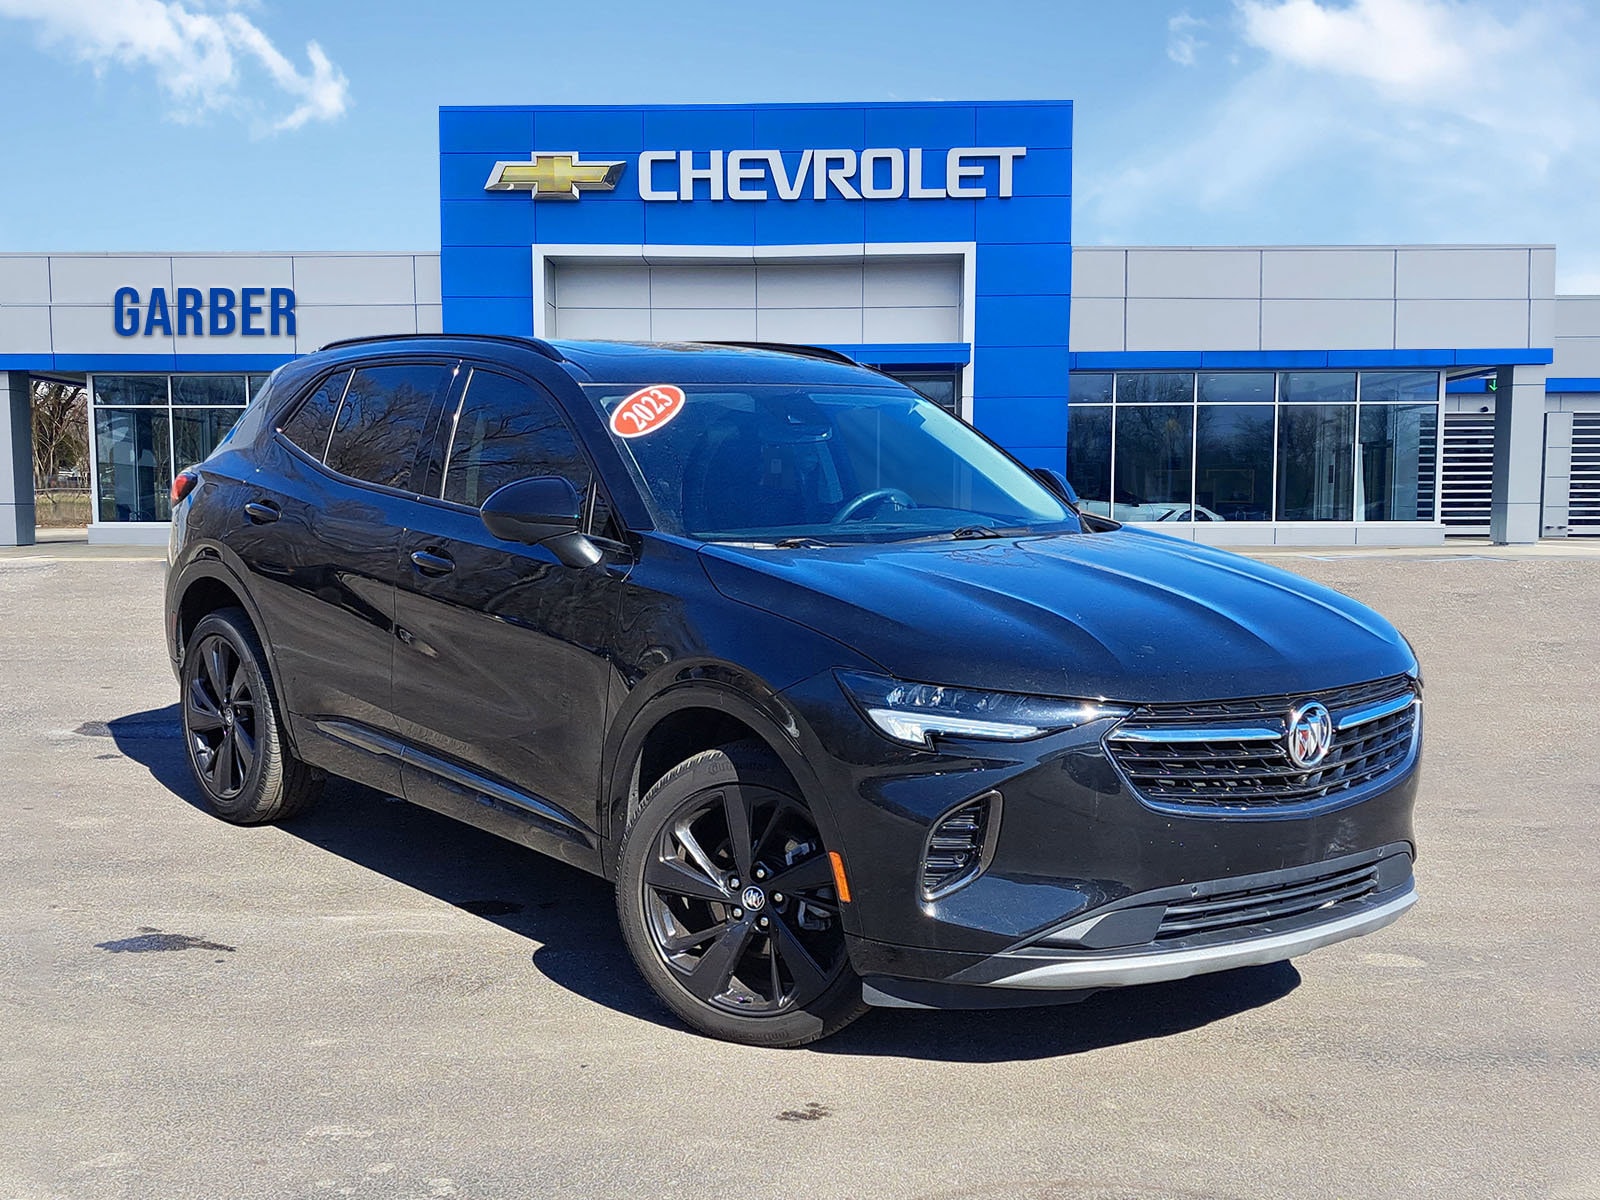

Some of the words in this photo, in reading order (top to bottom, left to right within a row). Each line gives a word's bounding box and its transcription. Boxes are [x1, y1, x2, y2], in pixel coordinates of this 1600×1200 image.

[638, 146, 1027, 202] CHEVROLET
[114, 286, 297, 337] GARBER
[622, 389, 673, 431] 2023
